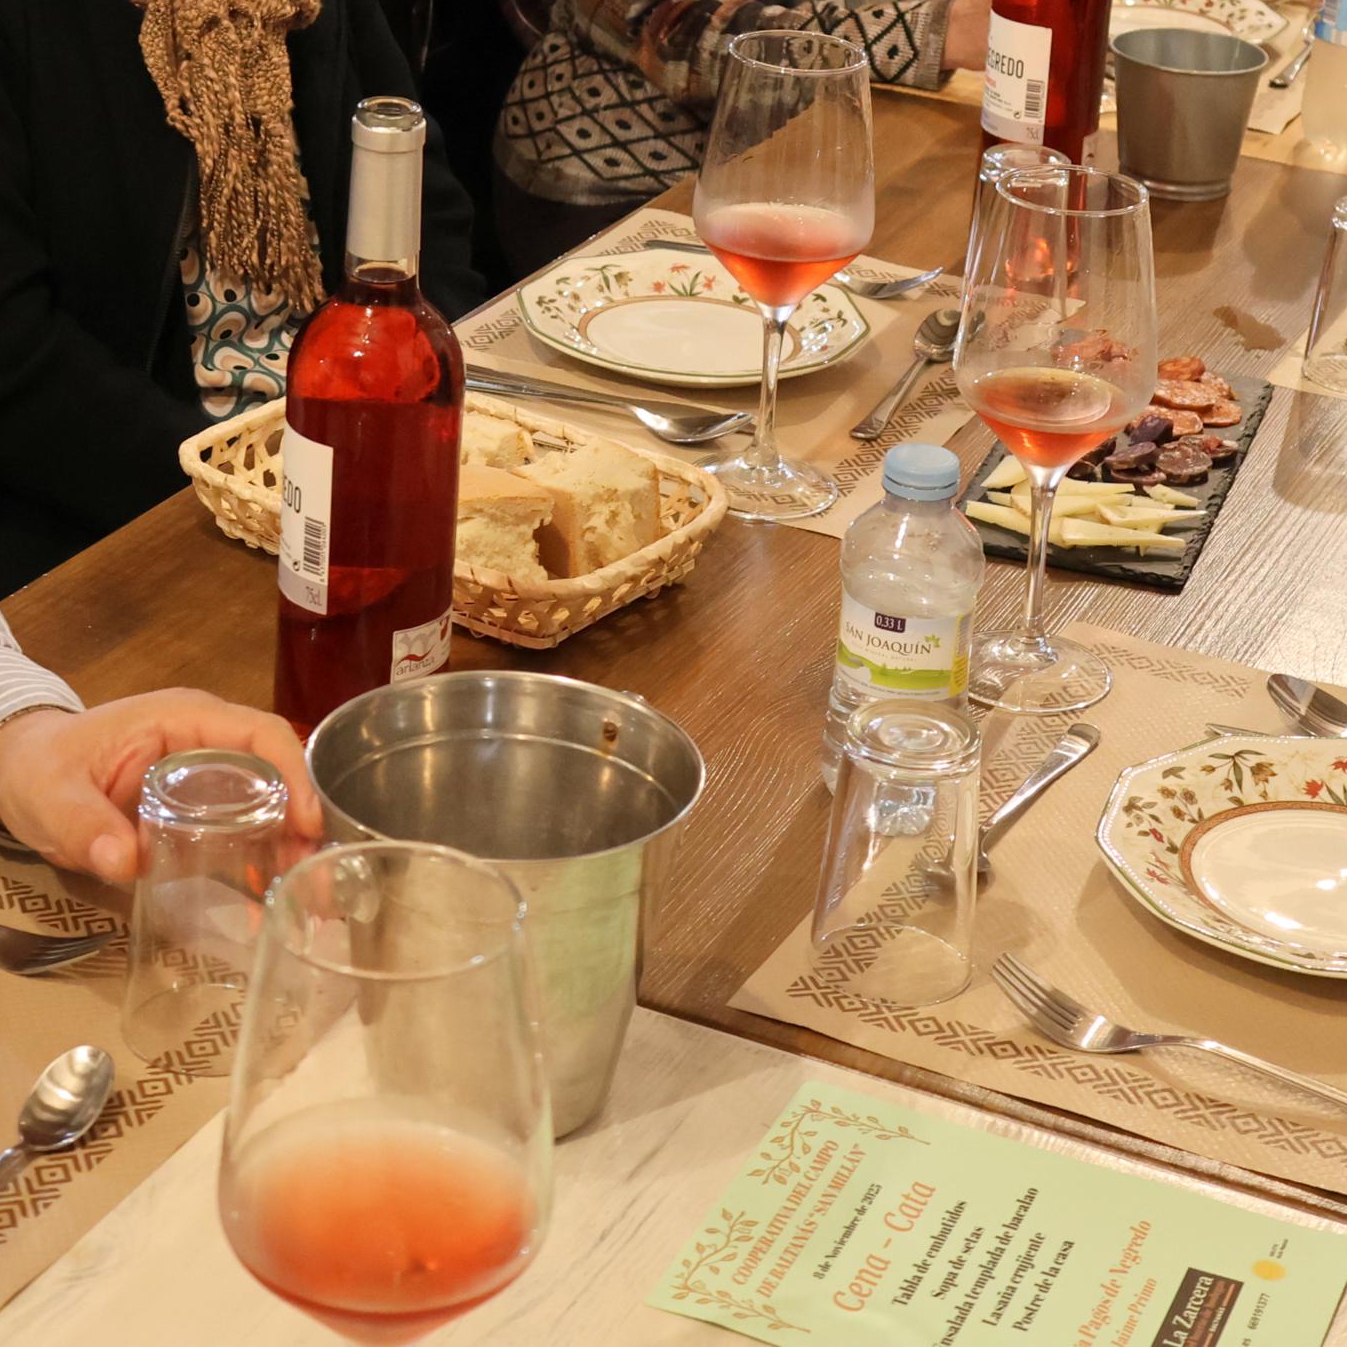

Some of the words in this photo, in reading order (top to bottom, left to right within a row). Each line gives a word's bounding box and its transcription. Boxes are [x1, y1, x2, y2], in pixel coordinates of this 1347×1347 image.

[987, 47, 1025, 79] EGREDO
[845, 621, 864, 641] SAN
[866, 633, 932, 657] JOAQUÍN
[875, 615, 895, 629] 0.33
[732, 1205, 797, 1285] COOPERATIVA
[786, 1182, 813, 1206] DEL
[804, 1140, 839, 1182] CAMPO
[854, 1203, 868, 1216] de
[860, 1183, 883, 1205] 2025
[1001, 1187, 1040, 1231] bacalao
[824, 1215, 861, 1260] Noviembre
[832, 1254, 891, 1313] Cena
[883, 1181, 937, 1232] Cata
[891, 1274, 924, 1307] Tabla
[912, 1258, 933, 1275] de
[925, 1200, 968, 1259] embutidos
[994, 1230, 1015, 1246] de
[1053, 1240, 1076, 1266] casa
[1108, 1220, 1152, 1275] Negredo
[756, 1278, 780, 1298] DE
[768, 1219, 819, 1280] BALTANÁS
[812, 1270, 826, 1280] 8
[817, 1259, 832, 1273] de
[930, 1269, 960, 1301] Sopa
[948, 1254, 968, 1271] de
[962, 1226, 985, 1256] setas
[964, 1246, 1007, 1300] templada
[1040, 1266, 1062, 1279] la
[981, 1285, 1018, 1327] Lasaña
[1009, 1232, 1047, 1286] crujiente
[1033, 1278, 1054, 1294] de
[1100, 1278, 1123, 1298] de
[1127, 1278, 1157, 1315] Primo
[1011, 1293, 1046, 1332] Postre
[1078, 1298, 1112, 1340] Pagos
[1172, 1275, 1215, 1329] Zarcera
